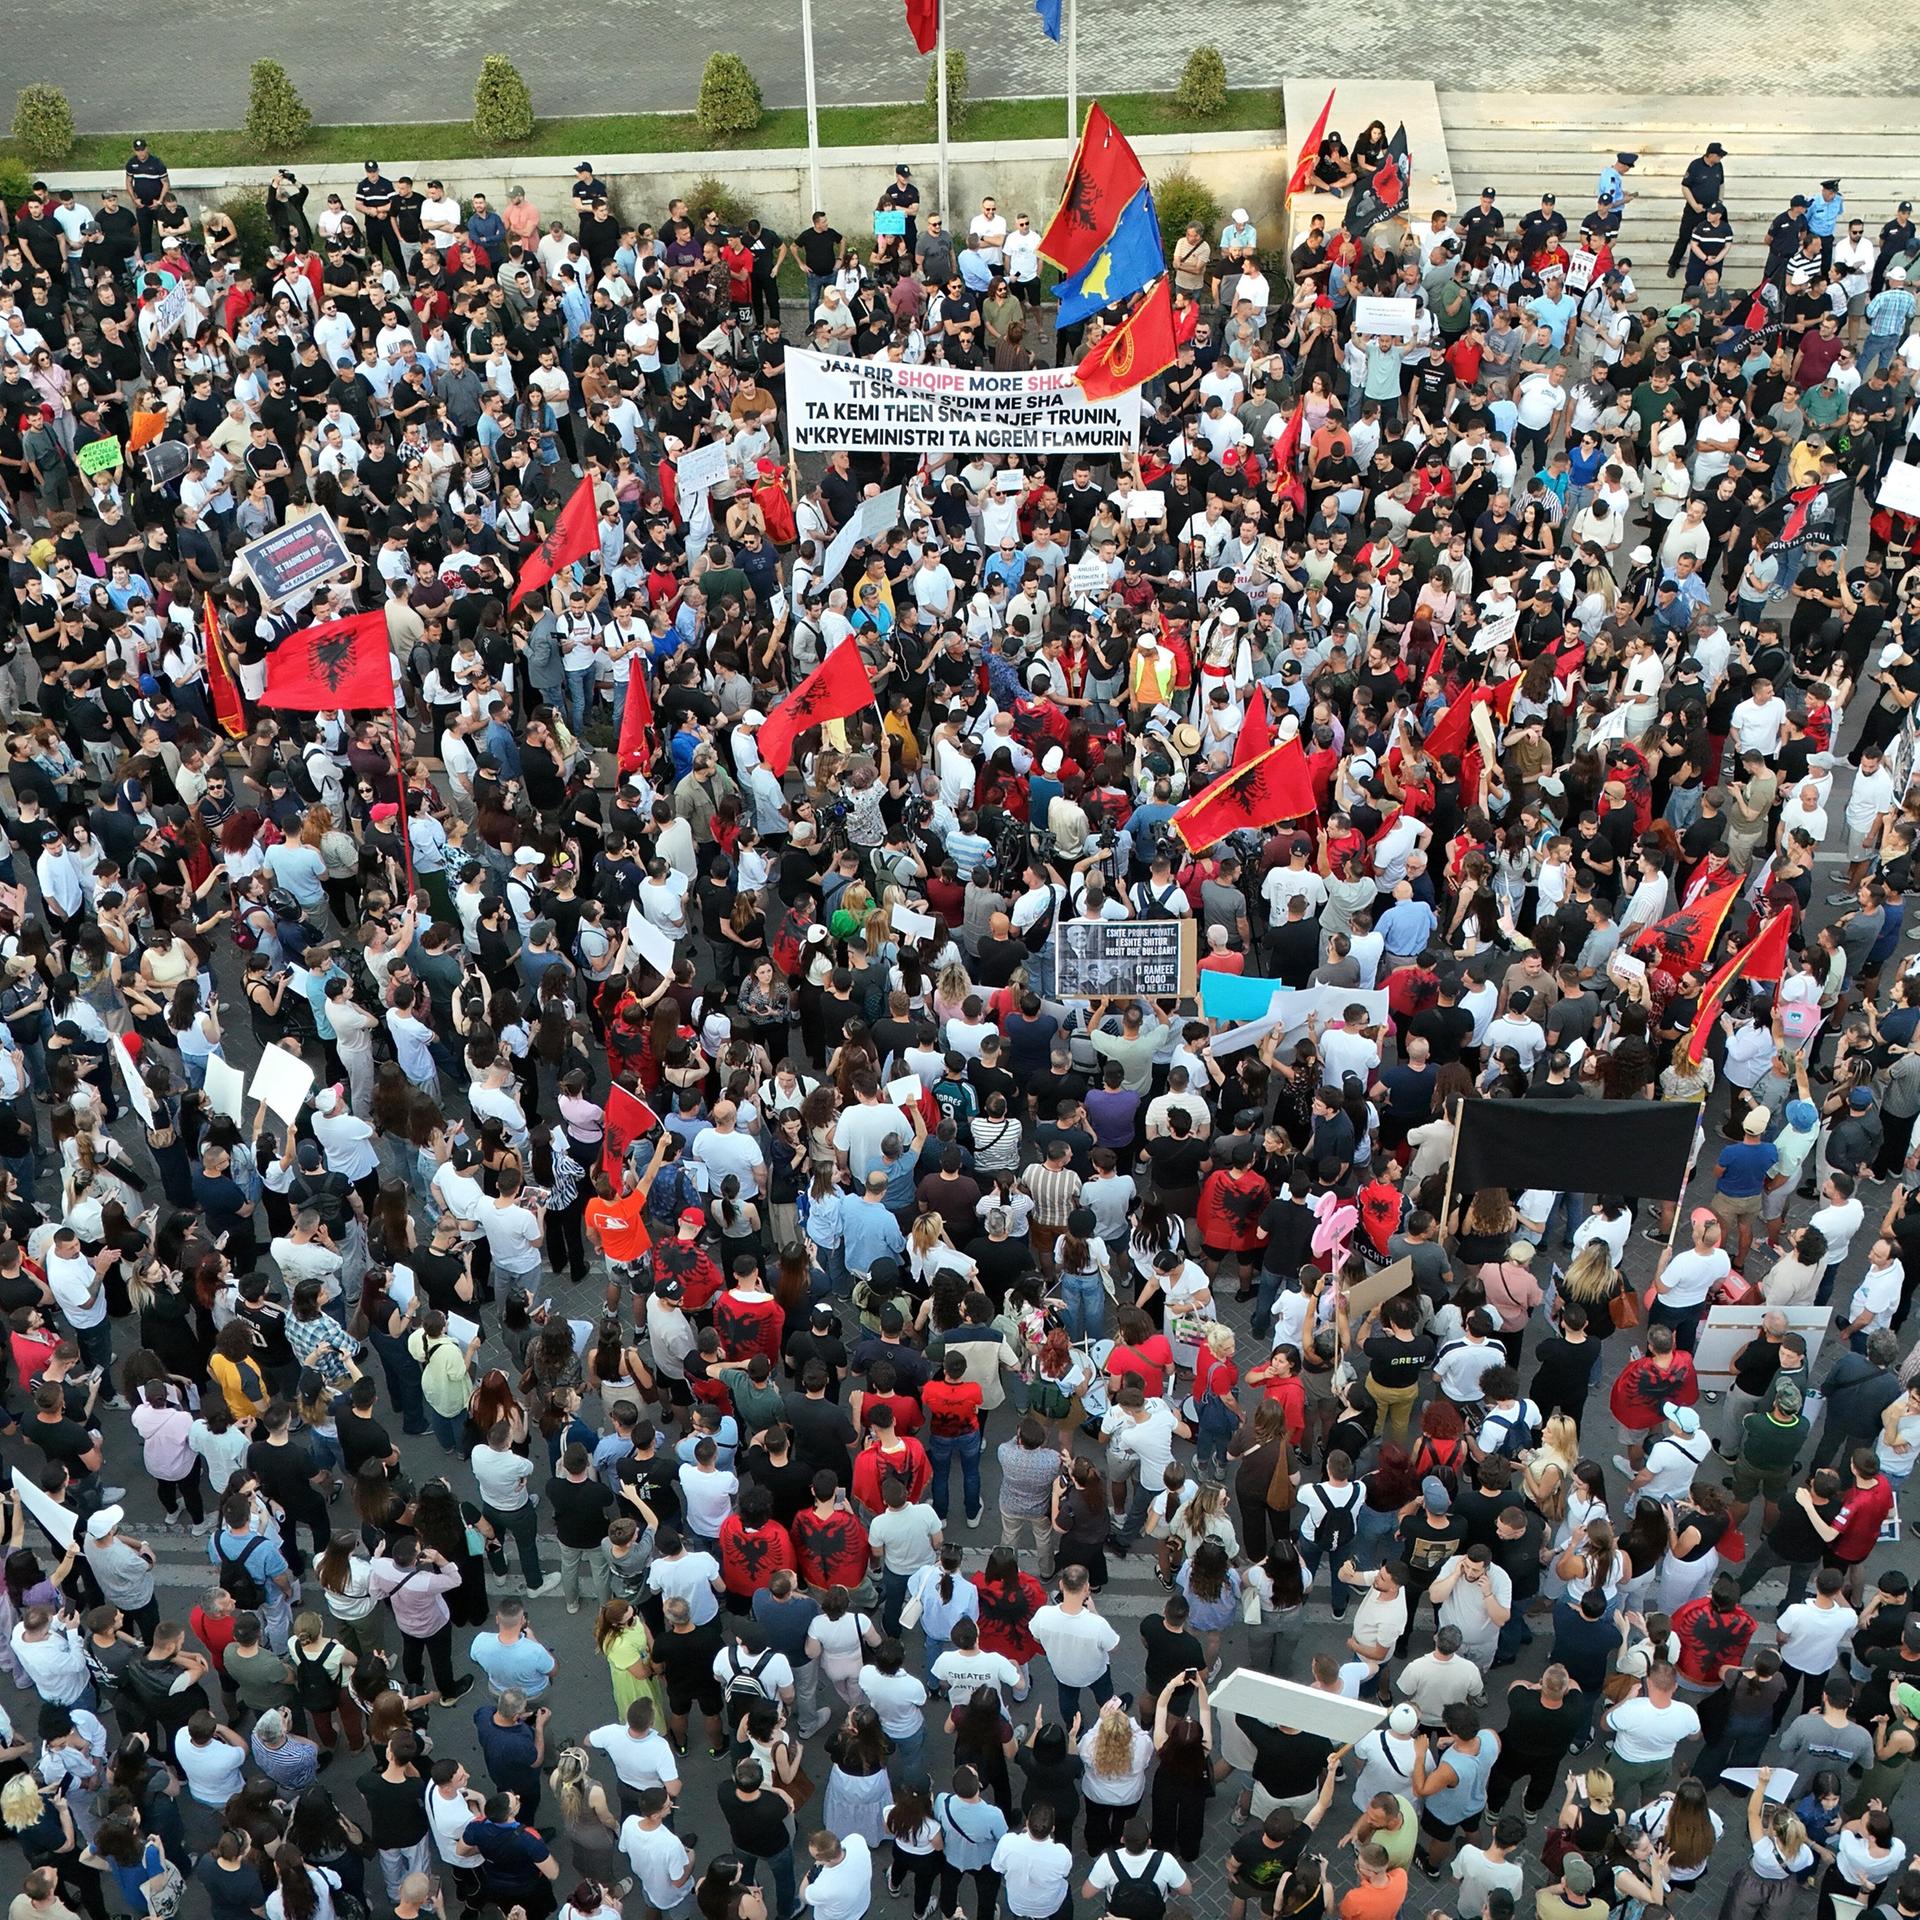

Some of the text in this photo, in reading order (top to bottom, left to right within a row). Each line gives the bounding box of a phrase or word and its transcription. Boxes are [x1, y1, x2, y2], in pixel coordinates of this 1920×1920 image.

[864, 366, 893, 383] BIR
[898, 370, 965, 392] SHQIPE
[969, 377, 1023, 392] MORE
[1028, 374, 1079, 391] SHKJ
[850, 381, 865, 398] TI
[871, 382, 908, 398] SHA
[940, 394, 990, 409] S'DIM
[995, 397, 1022, 410] ME
[1026, 394, 1063, 408] SHA
[806, 402, 829, 419] TA
[834, 403, 879, 421] KEMI
[884, 405, 933, 422] THEN
[996, 412, 1043, 426] NJEF
[1047, 408, 1122, 426] TRUNIN,
[796, 427, 1132, 447] N'KRYEMINISTRI TA NGREM FLAMURIN
[1143, 937, 1168, 946] SHITUR
[1106, 947, 1125, 956] RUSIT
[1127, 947, 1140, 956] DHE
[1136, 965, 1174, 975] O RAMEEE
[1136, 984, 1145, 992] PO
[942, 1103, 955, 1119] 9
[948, 1671, 991, 1680] CREATES
